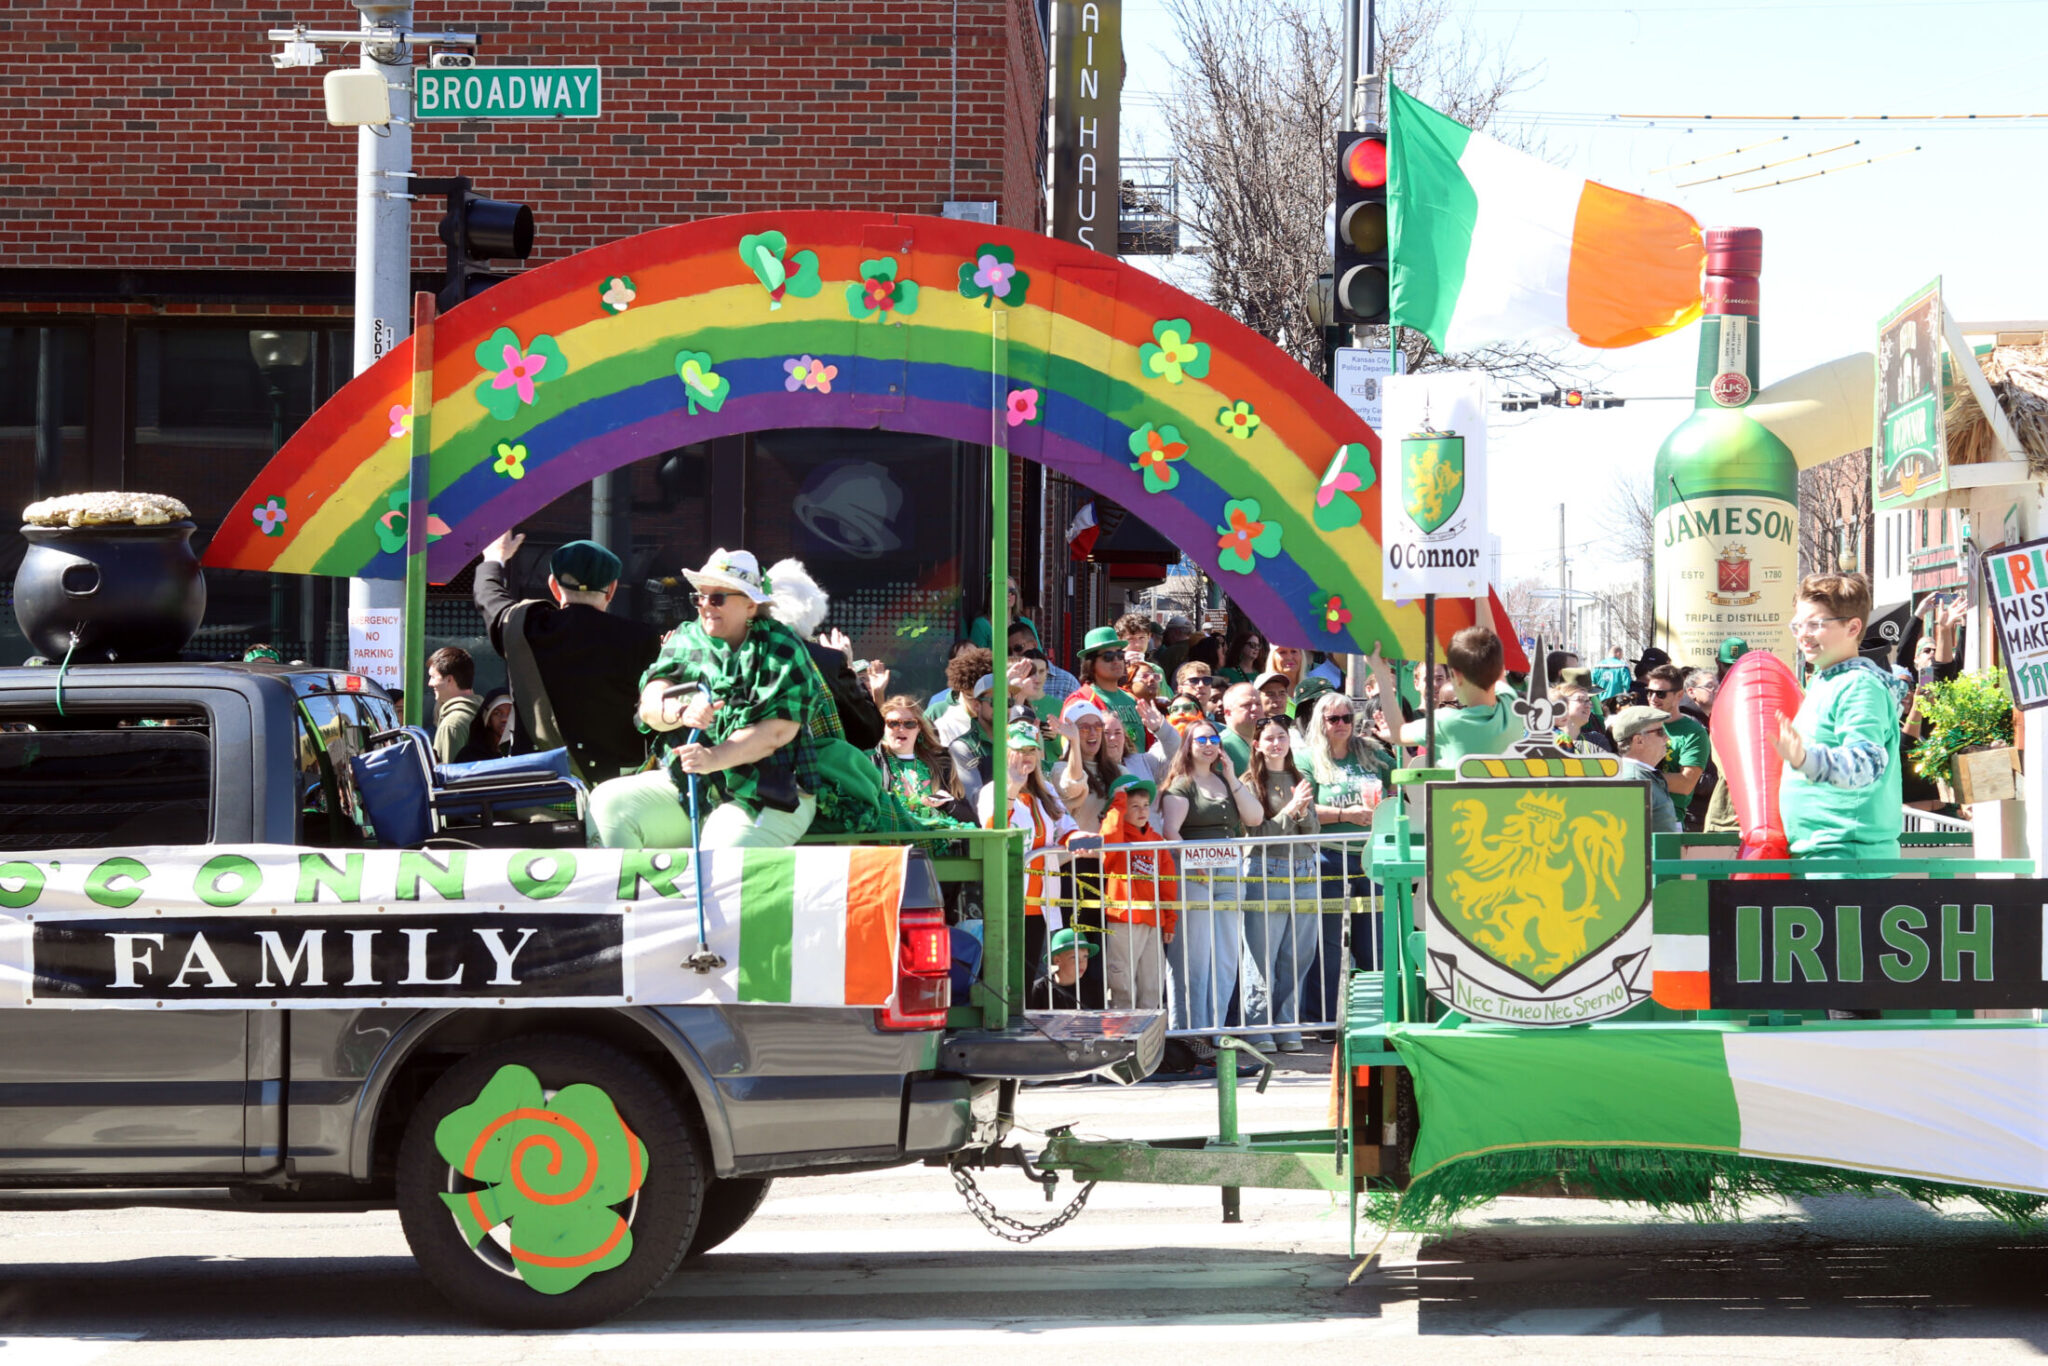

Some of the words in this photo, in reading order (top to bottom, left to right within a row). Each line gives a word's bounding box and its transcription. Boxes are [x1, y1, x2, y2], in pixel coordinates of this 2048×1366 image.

[1081, 2, 1099, 99] AIN
[422, 75, 592, 110] BROADWAY
[1078, 116, 1097, 252] HAUS
[1363, 365, 1400, 373] Departmt
[1376, 357, 1390, 365] City
[1665, 507, 1794, 548] JAMESON
[1764, 570, 1782, 579] 1780
[1992, 548, 2048, 598] IRI
[351, 616, 398, 625] EERGENCY
[1685, 613, 1723, 623] TRIPLE
[1727, 612, 1780, 622] DISTILLED
[2000, 592, 2048, 625] WIS
[365, 631, 380, 641] NO
[354, 648, 394, 658] PARKING
[384, 665, 398, 676] PM
[1185, 847, 1238, 859] NATIONAL
[0, 848, 689, 908] O'CONNOR
[104, 928, 538, 989] FAMILY
[1736, 904, 1994, 984] IRISH
[1456, 977, 1493, 1013] Nec
[1545, 1003, 1573, 1020] Nec
